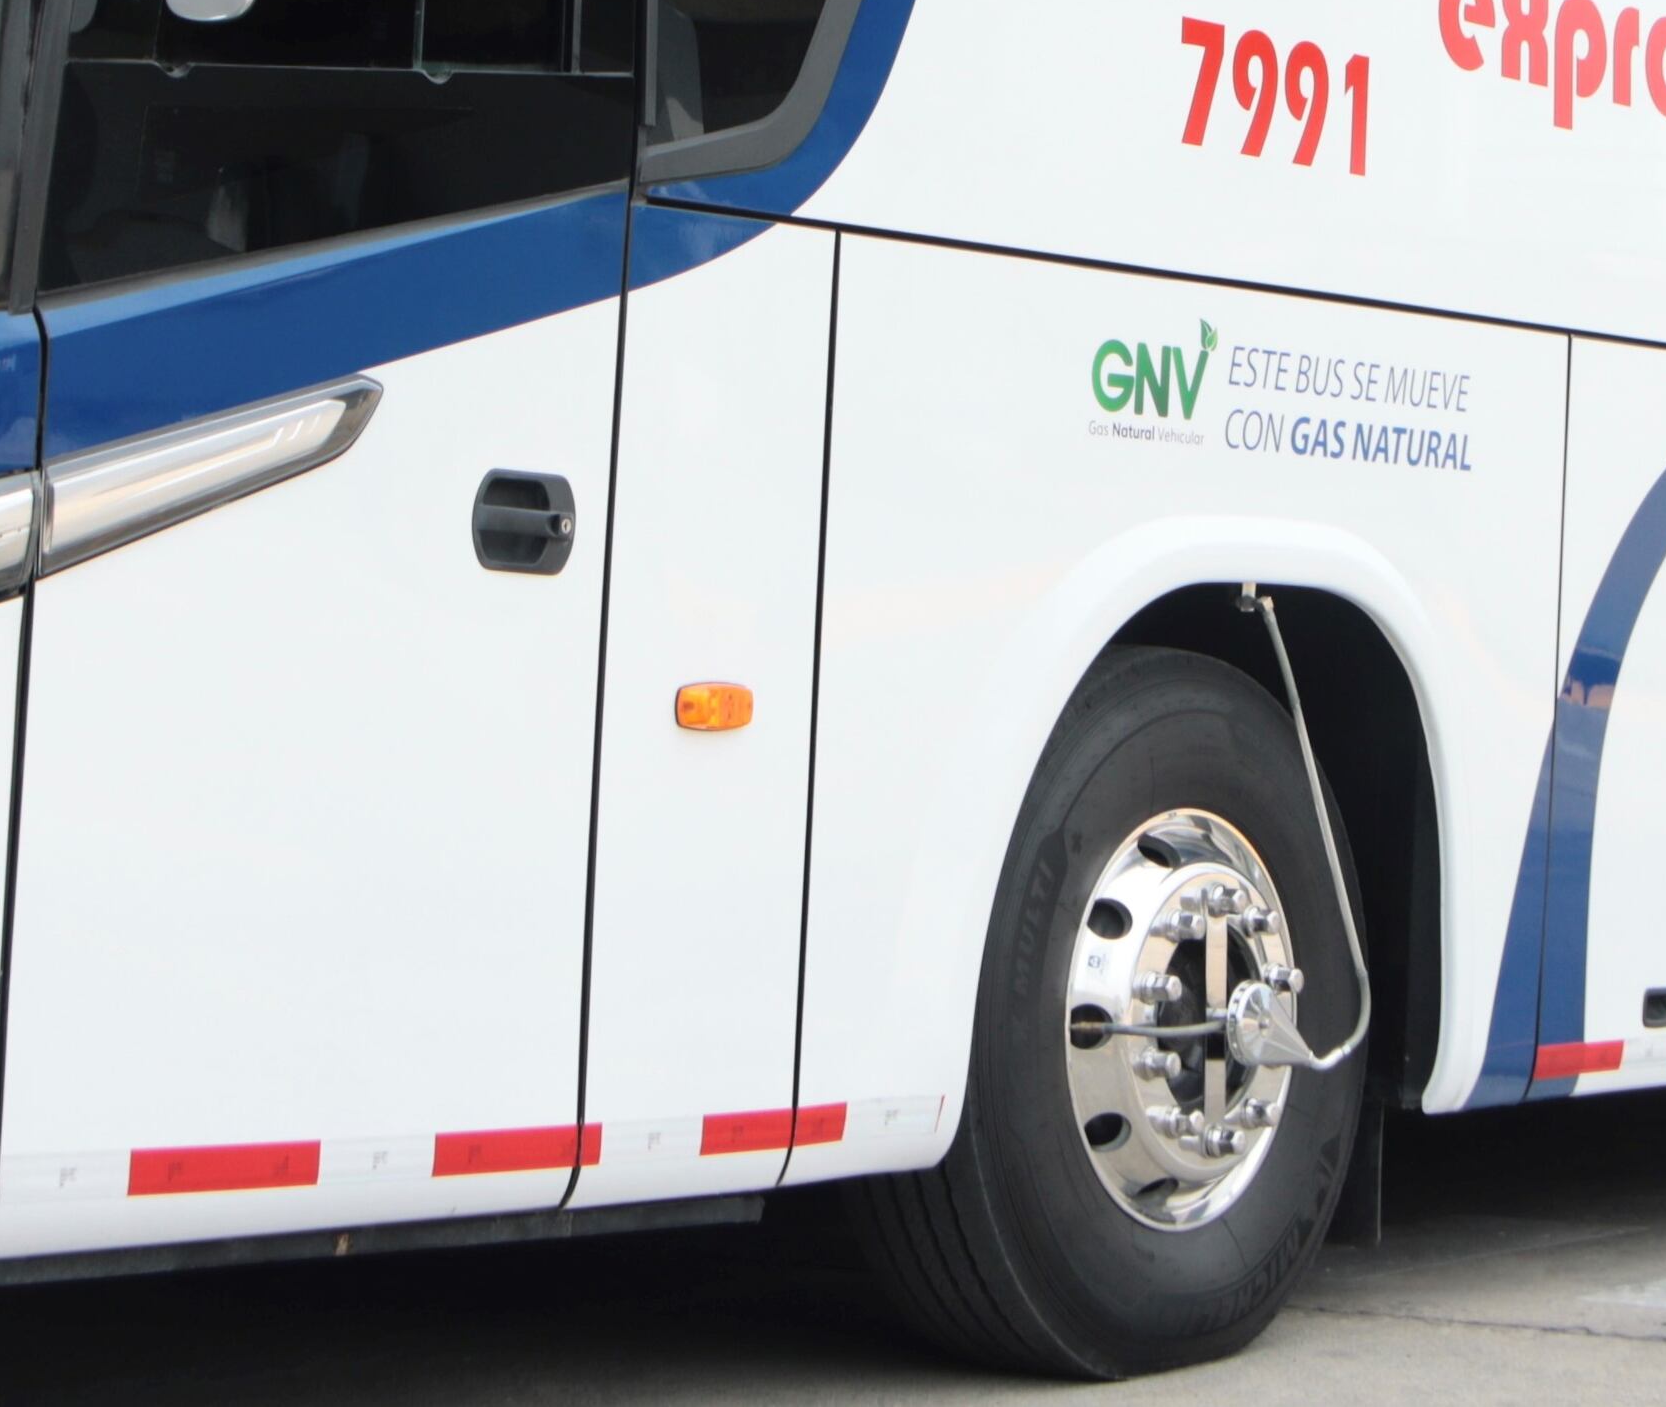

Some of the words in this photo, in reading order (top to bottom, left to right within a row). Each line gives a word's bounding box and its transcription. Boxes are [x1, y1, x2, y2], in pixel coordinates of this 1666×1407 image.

[1181, 16, 1371, 177] 7991
[1091, 339, 1209, 421] GNV
[1229, 346, 1291, 392] ESTE
[1295, 354, 1346, 398] BUS
[1350, 361, 1381, 402] SE
[1384, 366, 1471, 412] MUEVE
[1088, 420, 1109, 437] Gas
[1112, 422, 1156, 441] Natural
[1157, 427, 1205, 446] Vehicular
[1225, 408, 1285, 453] CON
[1290, 416, 1347, 459] GAS
[1352, 422, 1473, 472] NATURAL
